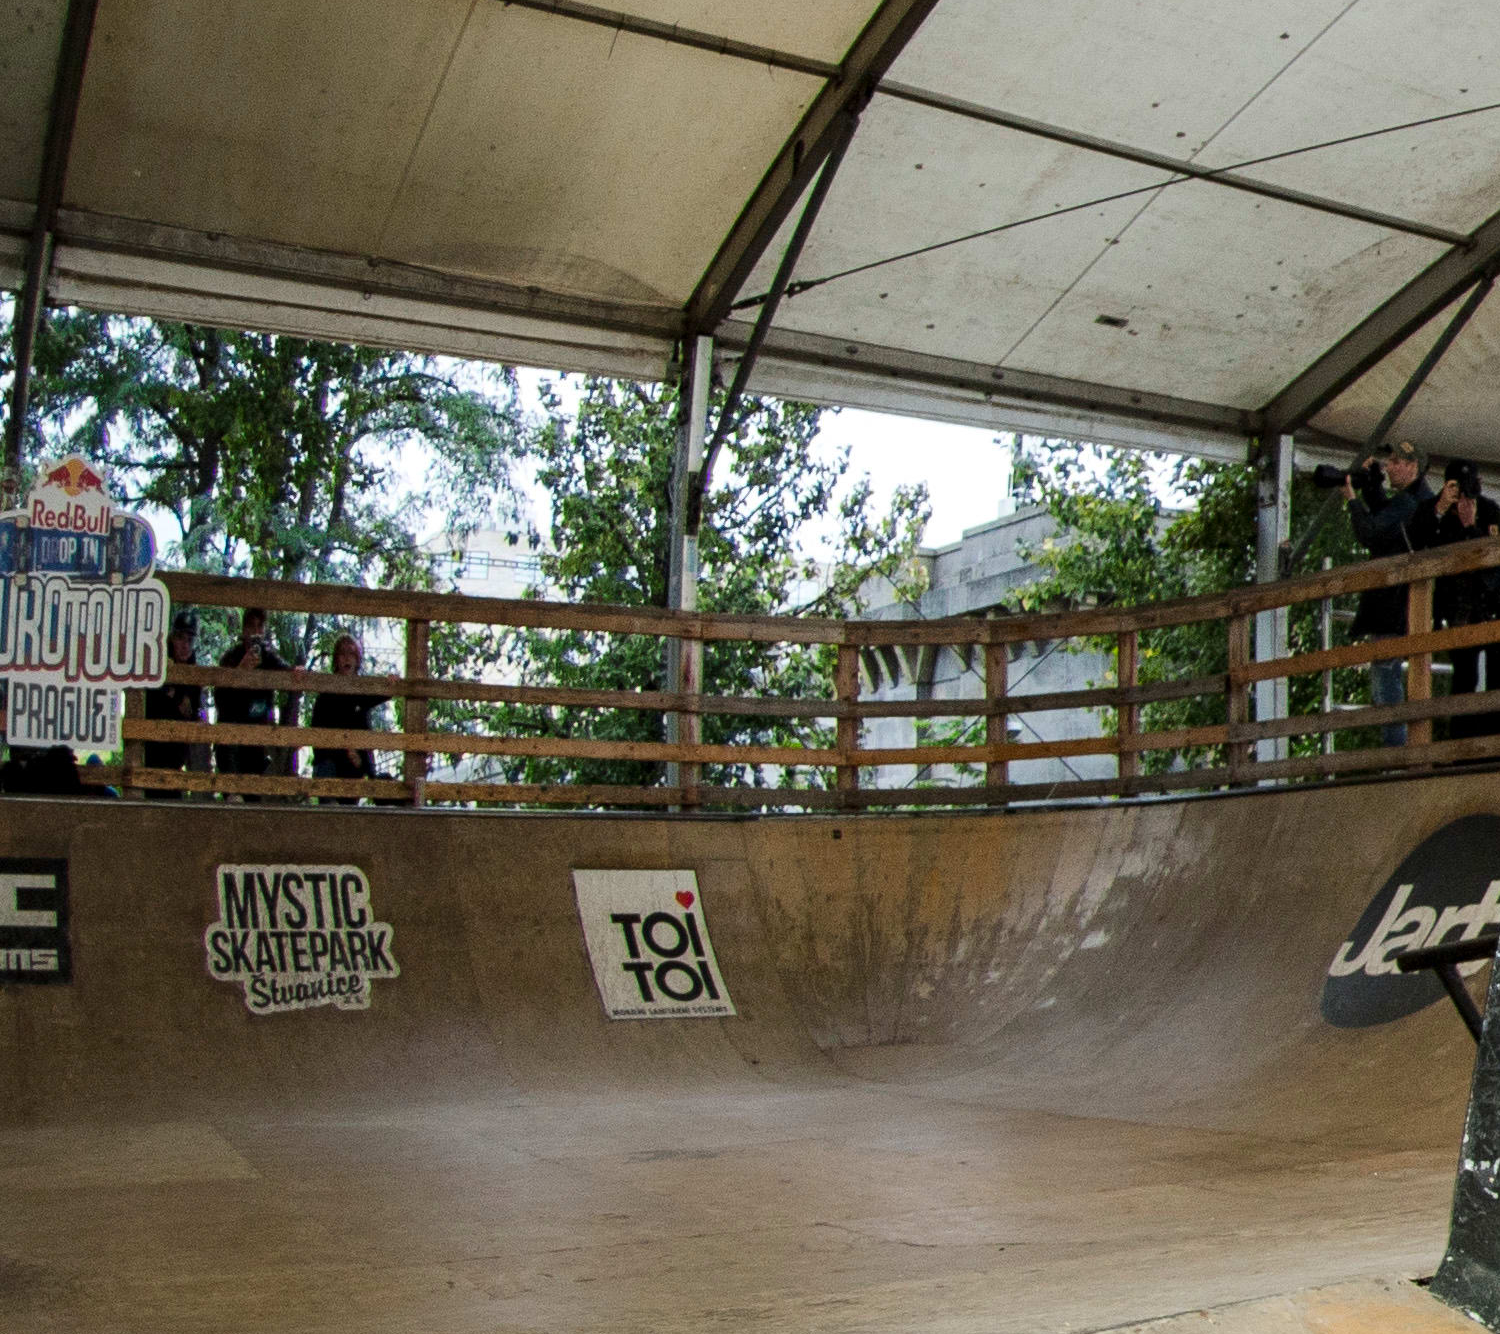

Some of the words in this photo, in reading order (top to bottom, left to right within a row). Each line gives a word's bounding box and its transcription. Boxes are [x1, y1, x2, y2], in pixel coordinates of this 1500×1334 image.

[31, 499, 71, 527] Red
[73, 504, 111, 534] Bull
[40, 536, 78, 565] DROP
[82, 537, 100, 565] IN
[11, 681, 108, 744] PRAGUE
[223, 872, 367, 929] MYSTIC
[211, 930, 394, 973] SKATEPARK
[610, 911, 705, 959] TOI
[622, 960, 720, 1002] TOI
